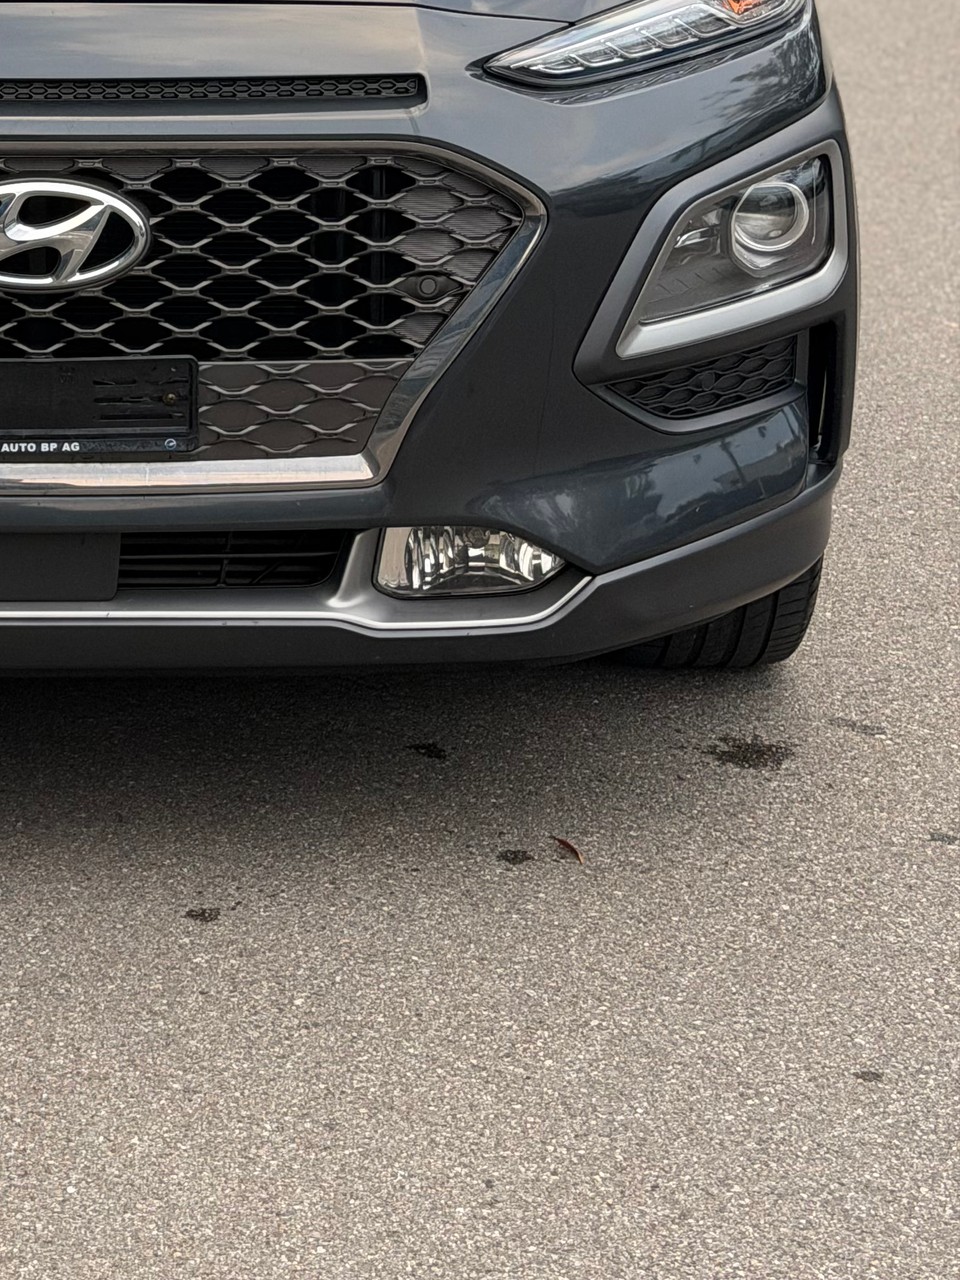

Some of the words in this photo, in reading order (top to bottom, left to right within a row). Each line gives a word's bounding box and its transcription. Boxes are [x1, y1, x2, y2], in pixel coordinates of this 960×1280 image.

[1, 442, 37, 453] AUTO
[40, 442, 58, 452] BP
[61, 442, 80, 452] AG
